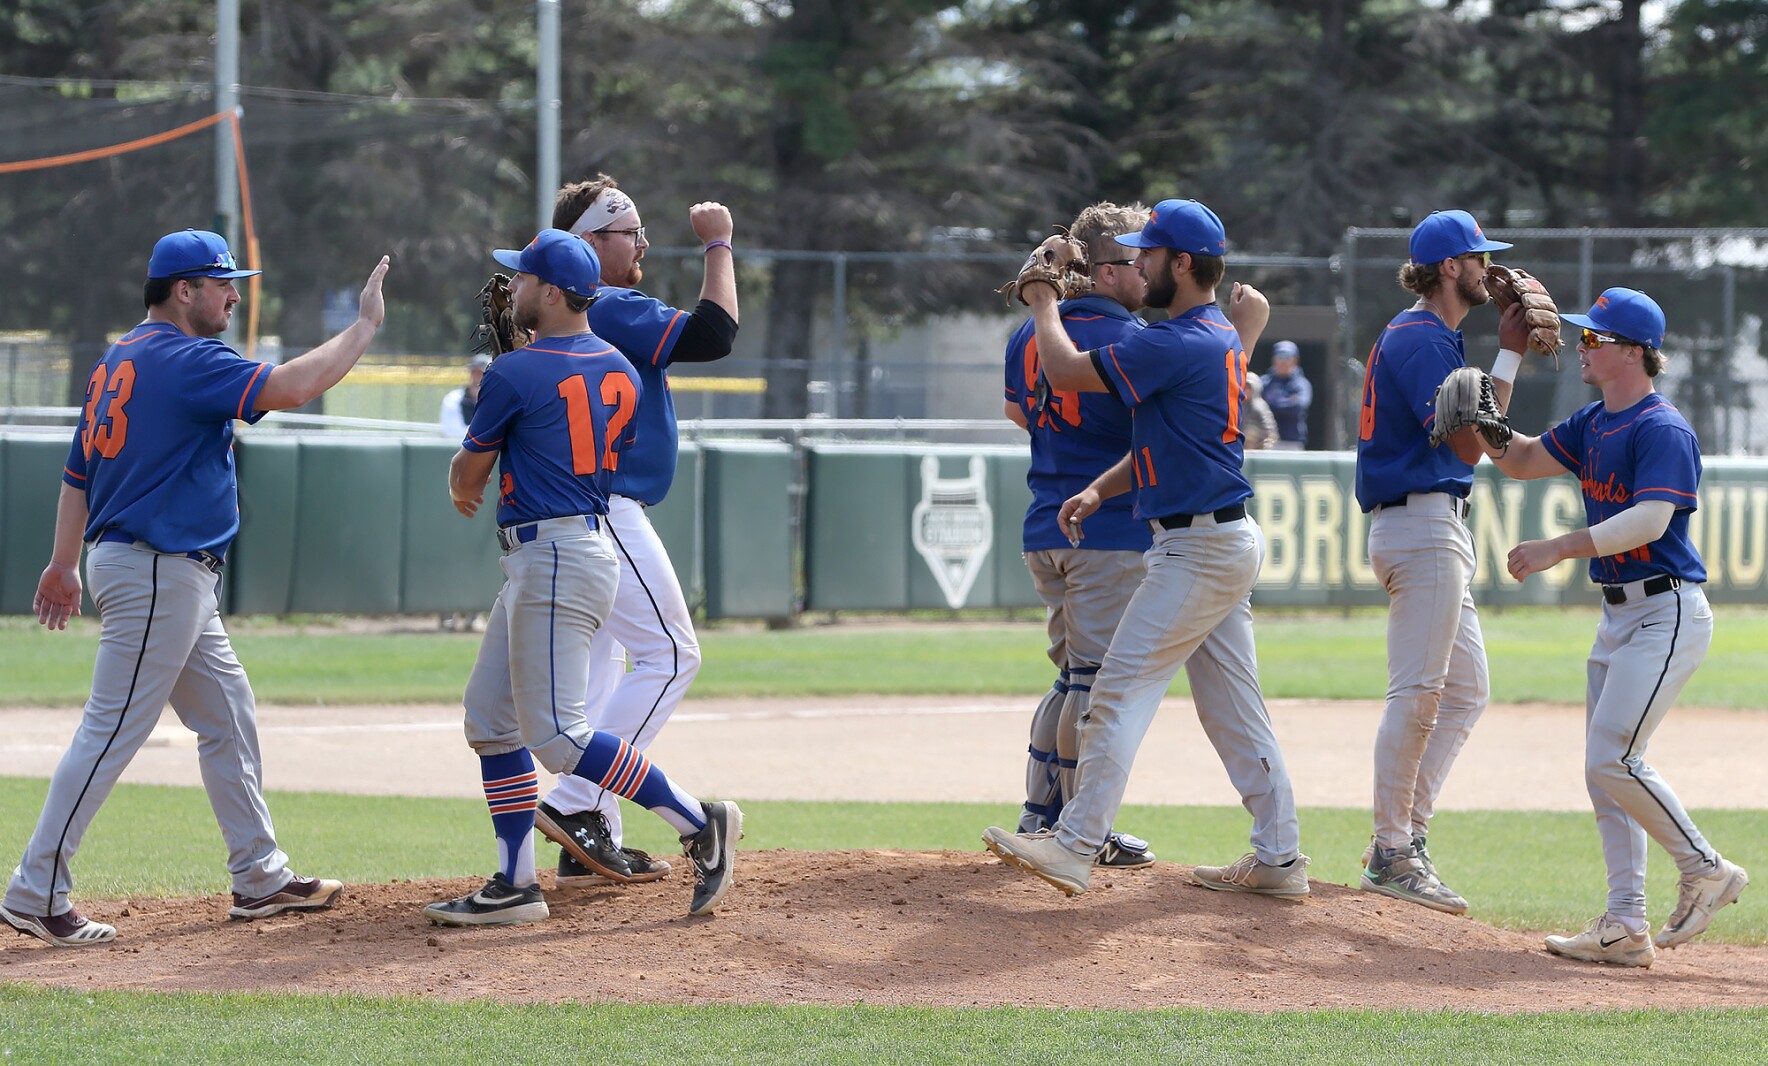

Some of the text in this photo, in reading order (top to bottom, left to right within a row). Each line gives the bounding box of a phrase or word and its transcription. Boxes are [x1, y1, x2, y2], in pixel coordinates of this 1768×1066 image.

[81, 359, 137, 463] 33
[557, 371, 637, 476] 12
[1253, 475, 1526, 590] BRON
